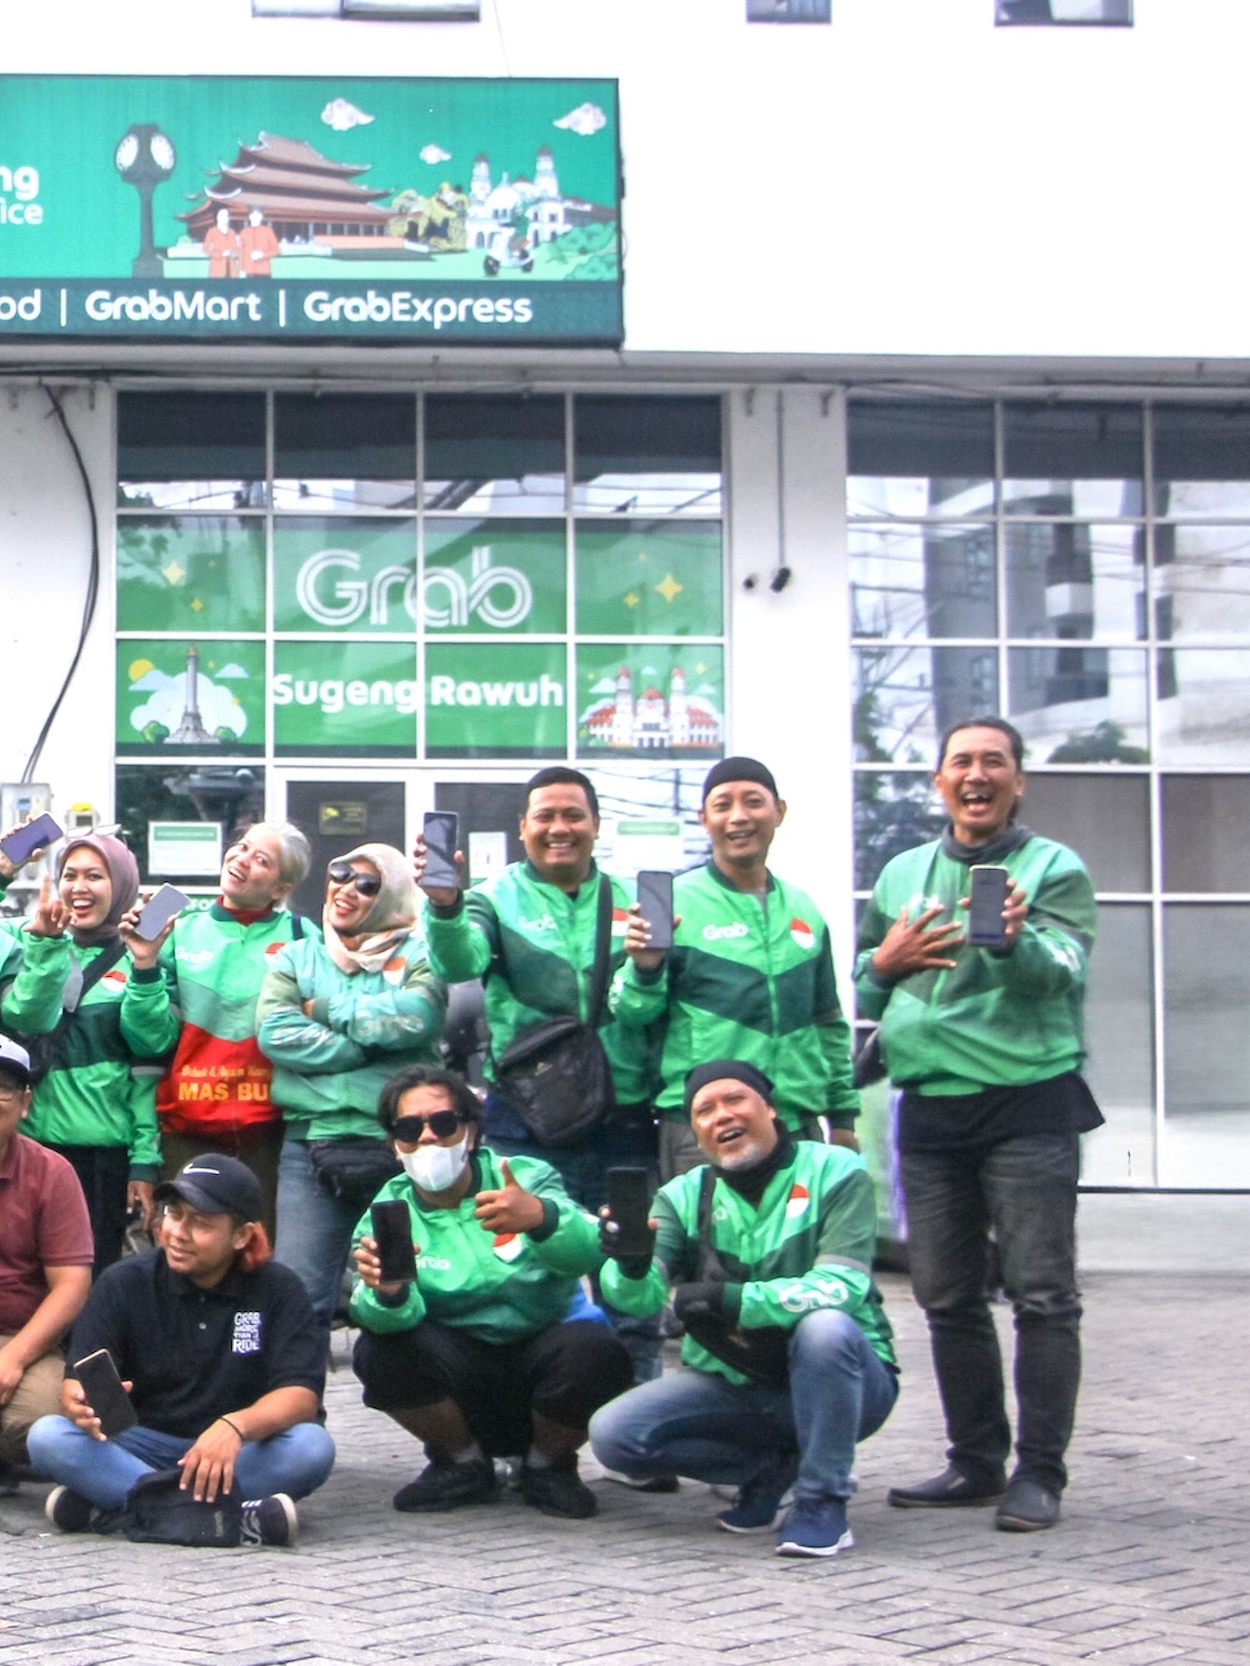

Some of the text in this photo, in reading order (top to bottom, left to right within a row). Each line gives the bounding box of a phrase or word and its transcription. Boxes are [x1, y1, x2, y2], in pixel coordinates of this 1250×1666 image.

[85, 290, 261, 321] GrabMart
[304, 291, 532, 329] GrabExpress
[296, 546, 532, 627] Grab
[273, 673, 563, 713] Sugeng Rawuh
[702, 921, 748, 940] Grab
[179, 1083, 229, 1101] MAS
[232, 1339, 260, 1354] RIDE
